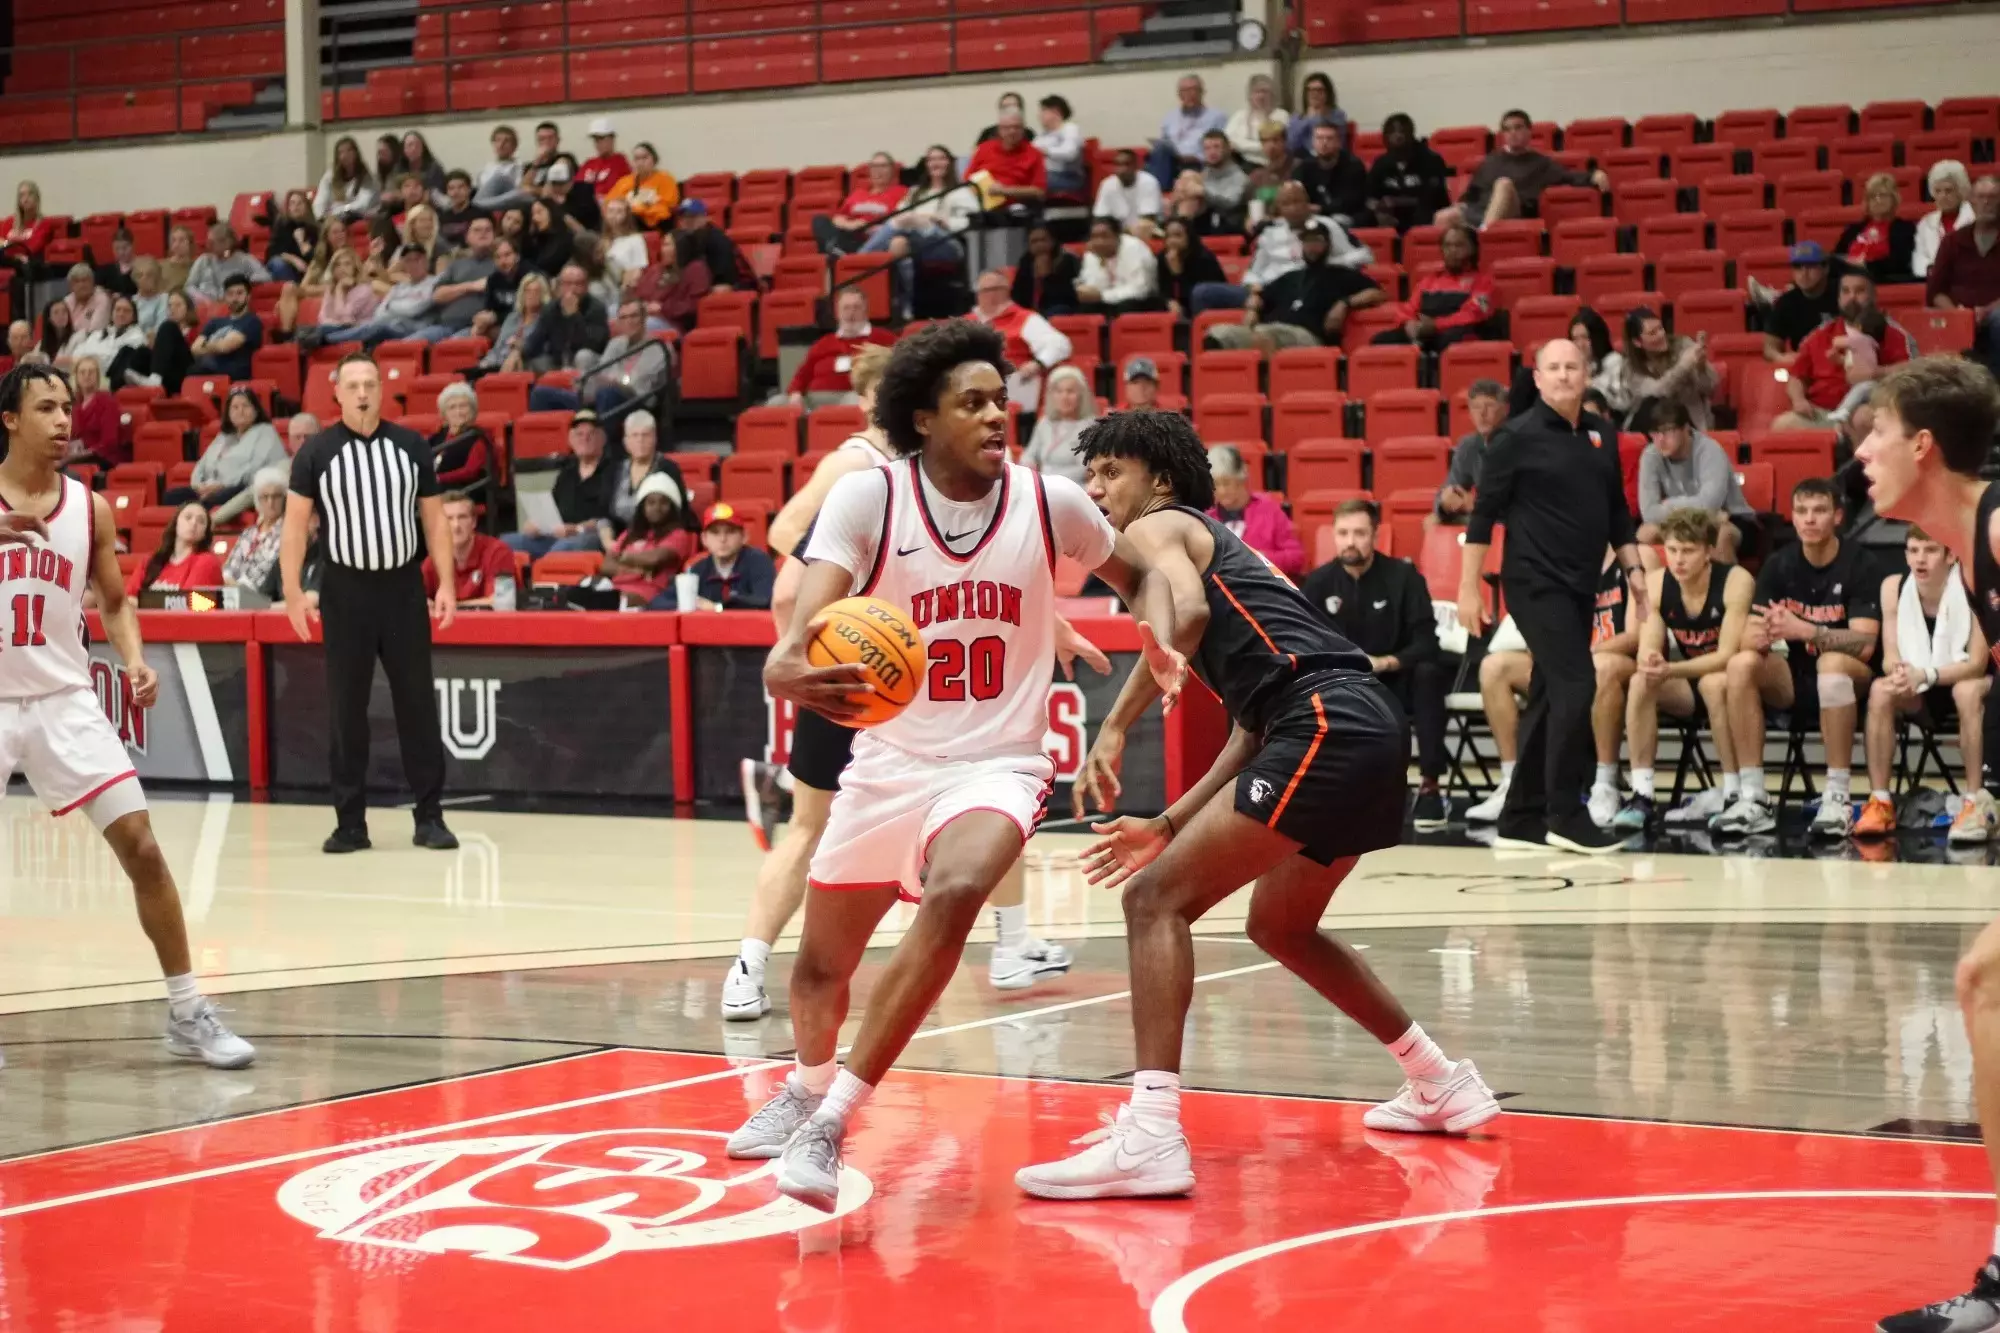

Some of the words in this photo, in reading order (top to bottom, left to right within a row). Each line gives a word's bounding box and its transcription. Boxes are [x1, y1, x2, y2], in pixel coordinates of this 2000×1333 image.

[0, 547, 73, 593] NION
[11, 594, 46, 647] 11
[865, 604, 917, 649] NCAA
[911, 580, 1022, 630] UNION
[834, 620, 905, 691] Wilson
[928, 635, 1005, 701] 20
[434, 678, 501, 760] U
